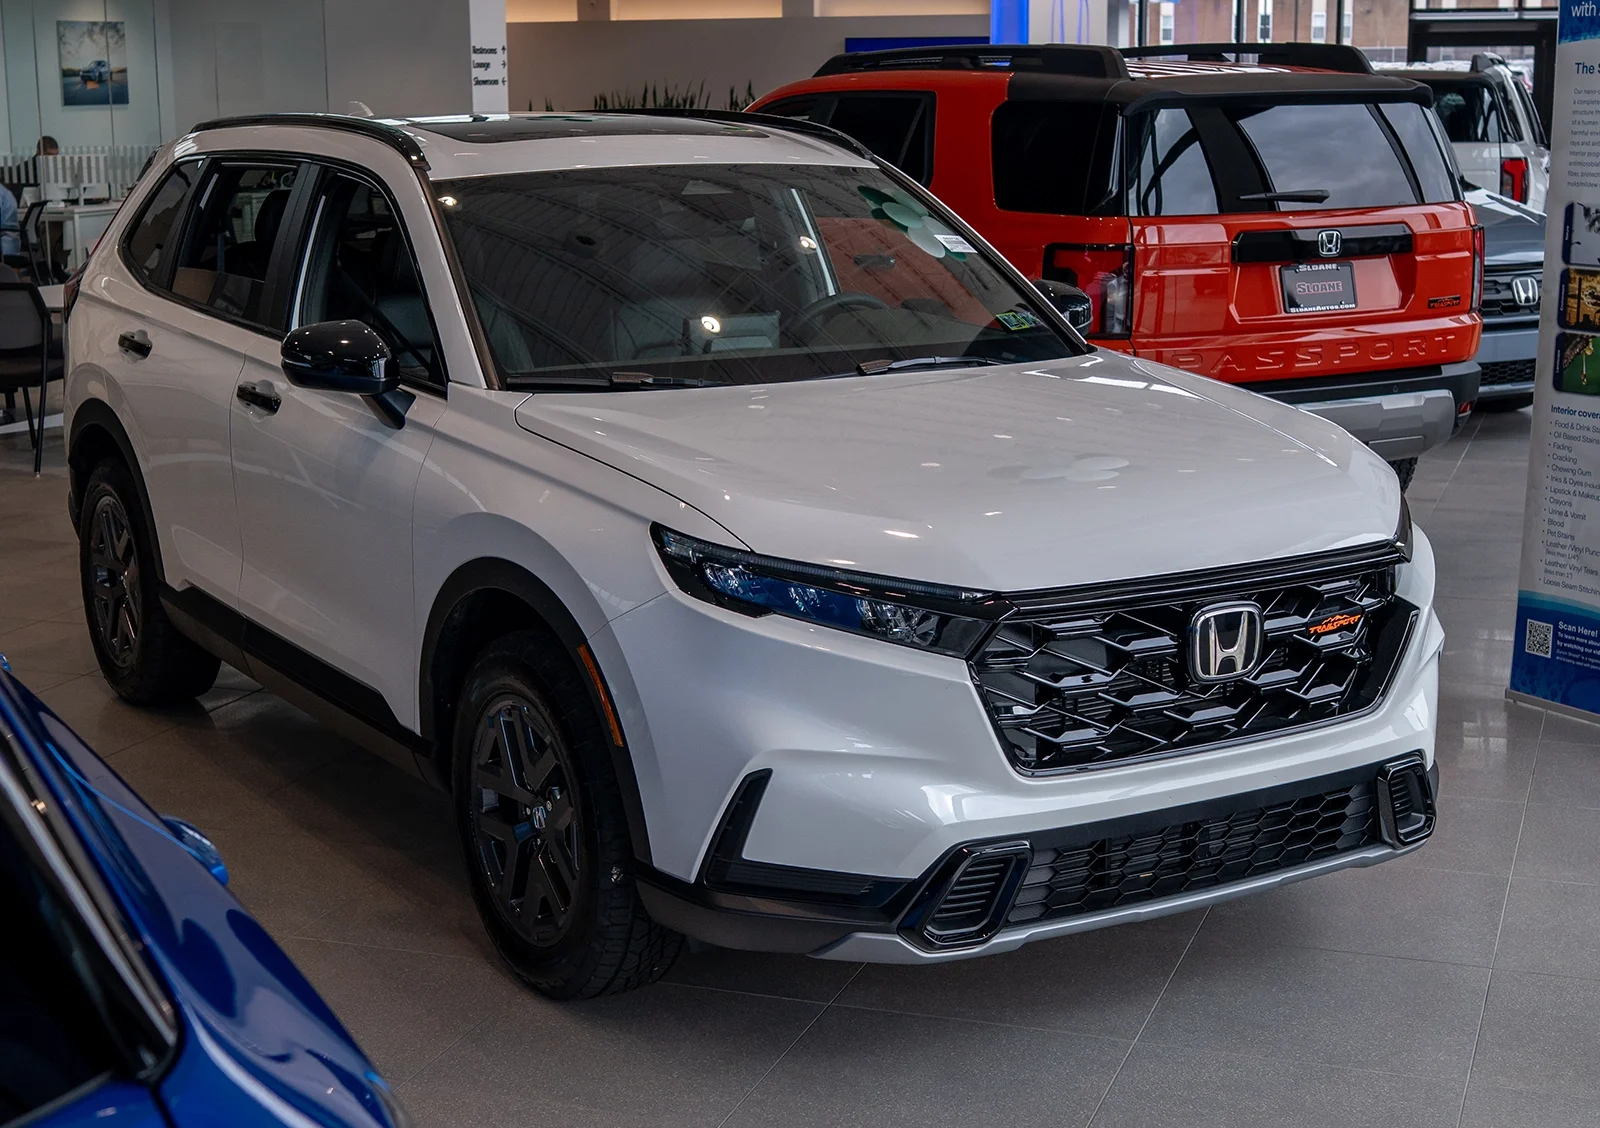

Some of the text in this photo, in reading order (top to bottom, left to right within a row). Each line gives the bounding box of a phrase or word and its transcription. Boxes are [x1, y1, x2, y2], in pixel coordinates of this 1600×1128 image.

[1571, 1, 1596, 17] with
[1575, 62, 1595, 75] The
[1298, 264, 1338, 272] SLOANE
[1296, 281, 1343, 294] SLOANE
[1171, 335, 1456, 374] PASSPORT
[1551, 404, 1577, 416] Interior
[1554, 420, 1570, 429] Food
[1576, 423, 1592, 432] Drink
[1554, 431, 1600, 444] Oil Based Stains
[1552, 442, 1572, 453] Fading
[1552, 453, 1578, 465] Cracking
[1552, 464, 1592, 477] Chewing Gum
[1550, 475, 1562, 484] Inks
[1568, 478, 1584, 487] Dyes
[1550, 486, 1572, 496] Lipstick
[1549, 496, 1572, 507] Crayons
[1548, 507, 1564, 516] Urine
[1570, 511, 1586, 520] Vomit
[1548, 518, 1564, 528] Blood
[1547, 529, 1575, 540] Pet Stains
[1584, 566, 1598, 576] Tears
[1543, 578, 1560, 588] Loose
[1561, 581, 1578, 591] Seam
[1309, 615, 1361, 635] TRAILSPORT
[1558, 620, 1598, 638] Scan Here!
